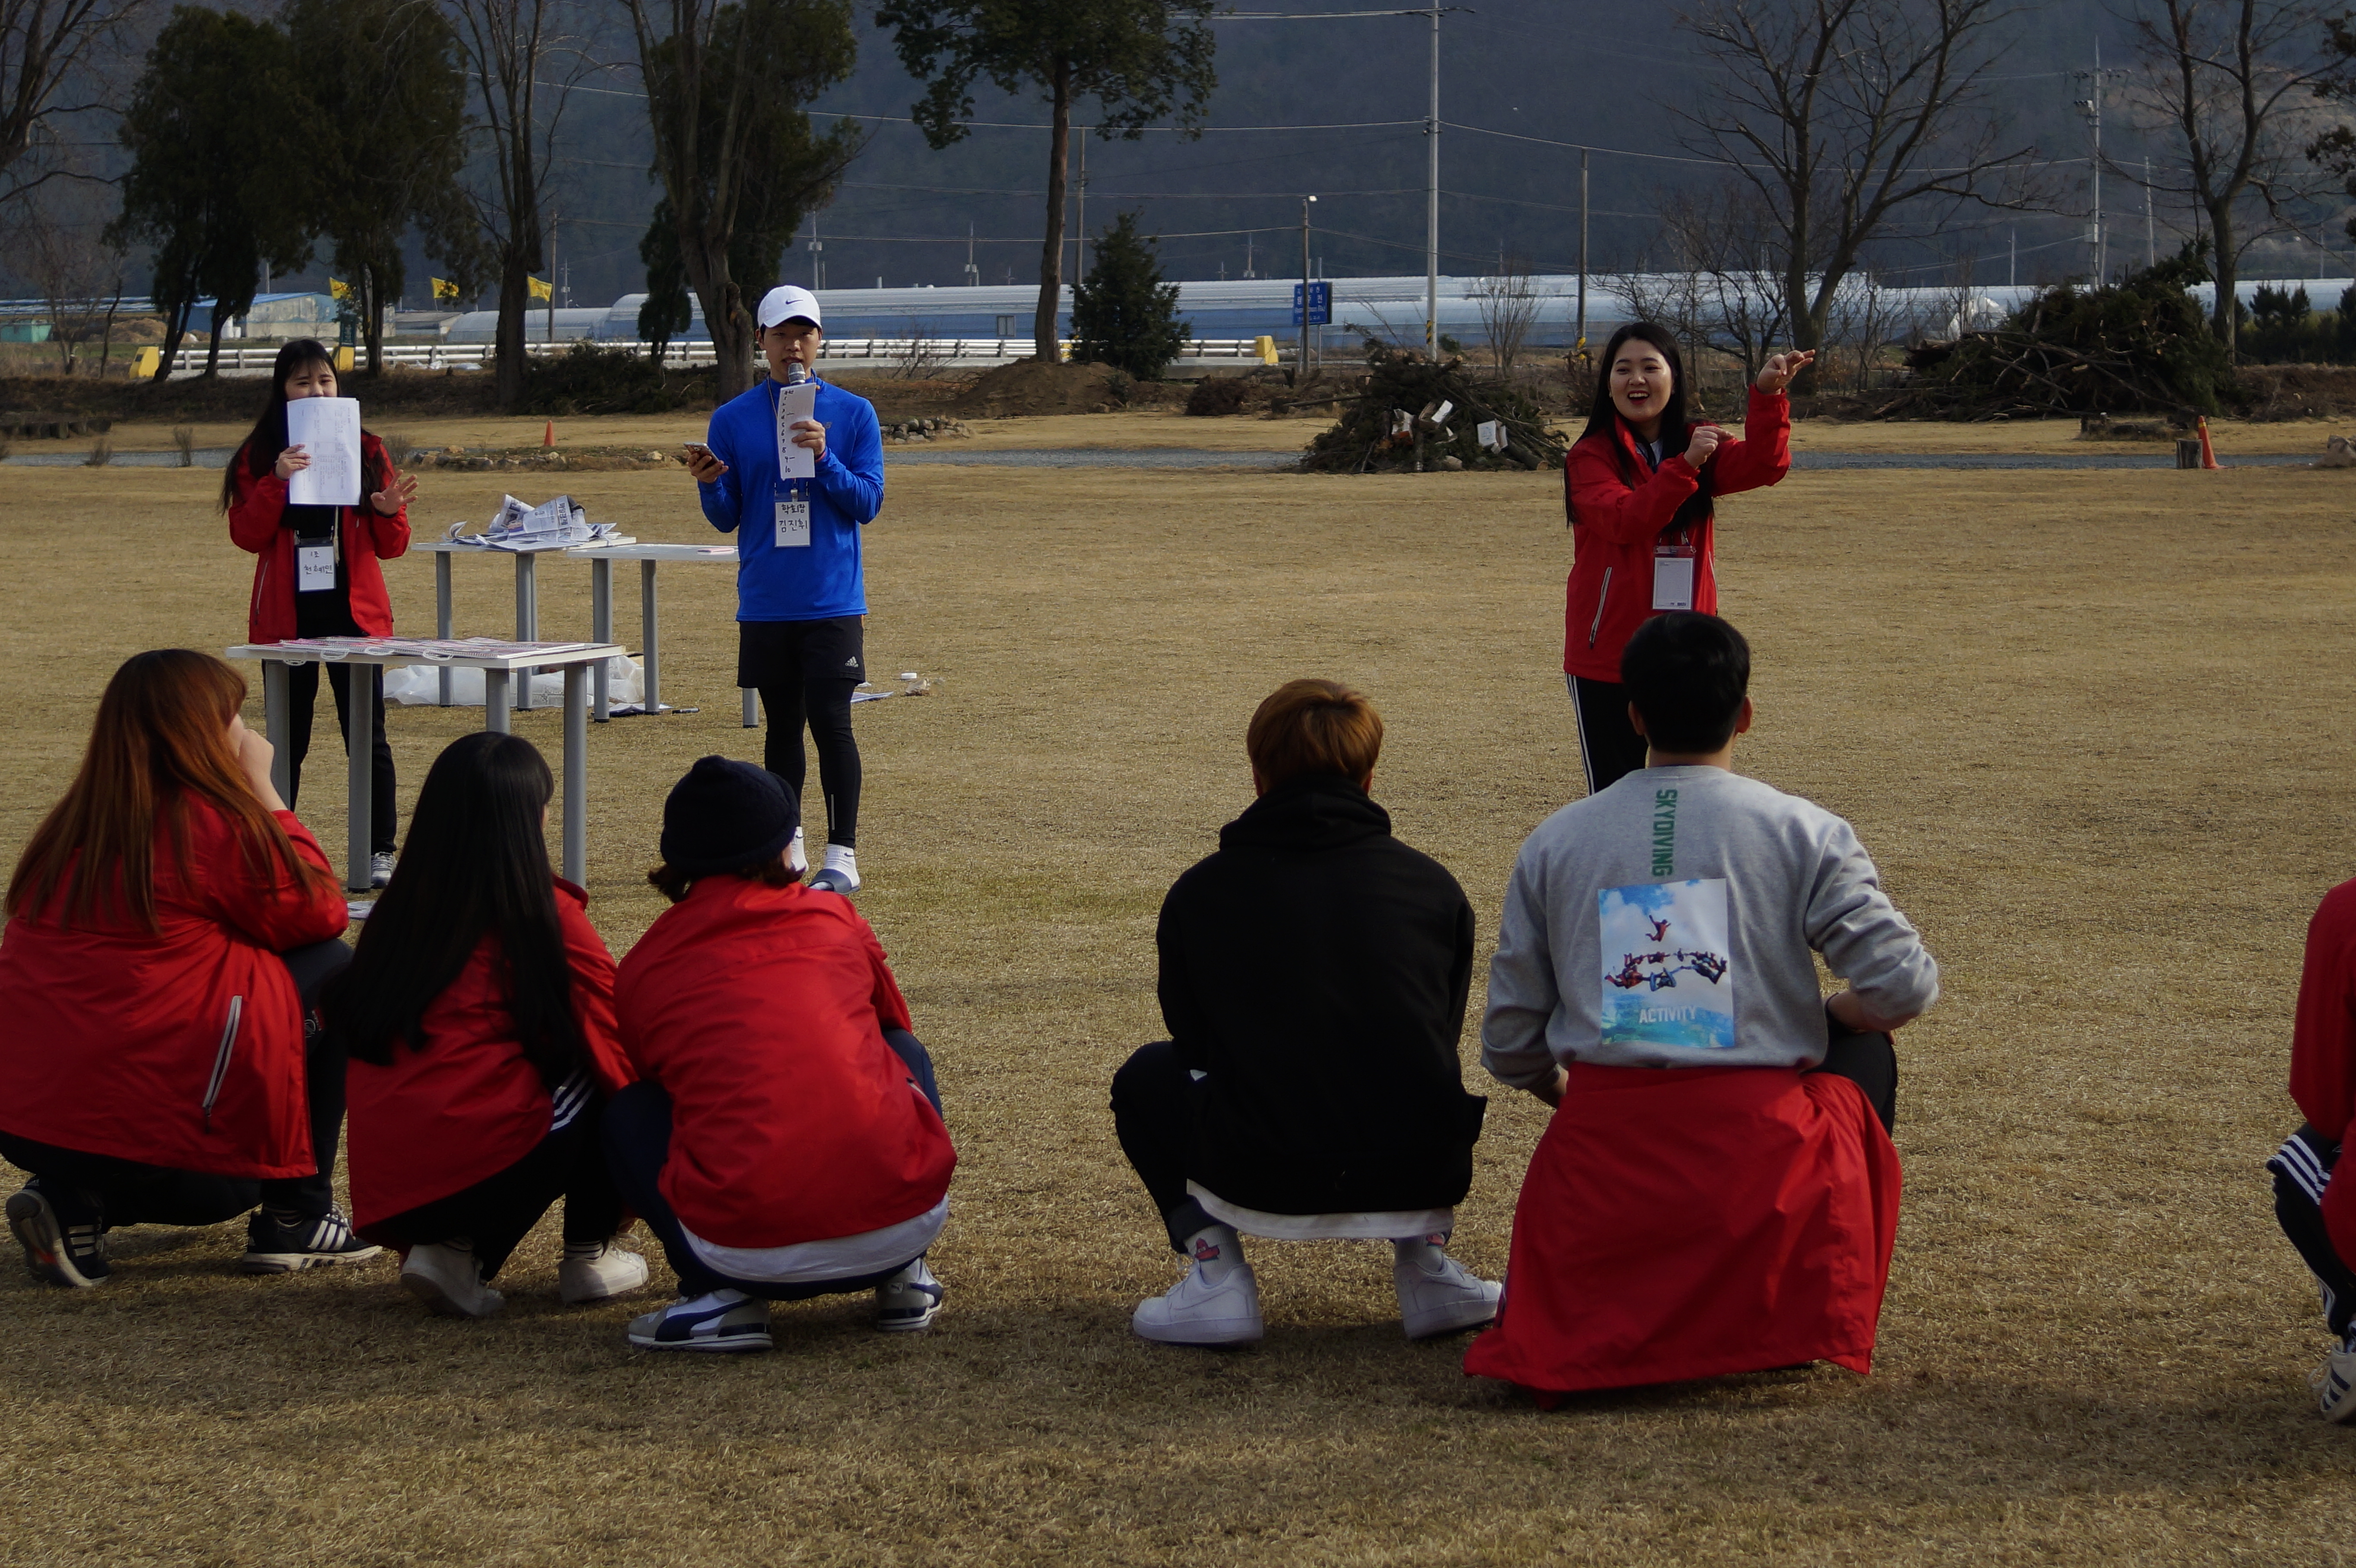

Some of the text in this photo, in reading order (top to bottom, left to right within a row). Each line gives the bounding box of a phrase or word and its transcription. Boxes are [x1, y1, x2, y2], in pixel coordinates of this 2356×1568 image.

[779, 518, 808, 533] 김진휘
[1651, 789, 1678, 876] SKYDIVING
[1639, 1006, 1696, 1023] ACTIVITY
